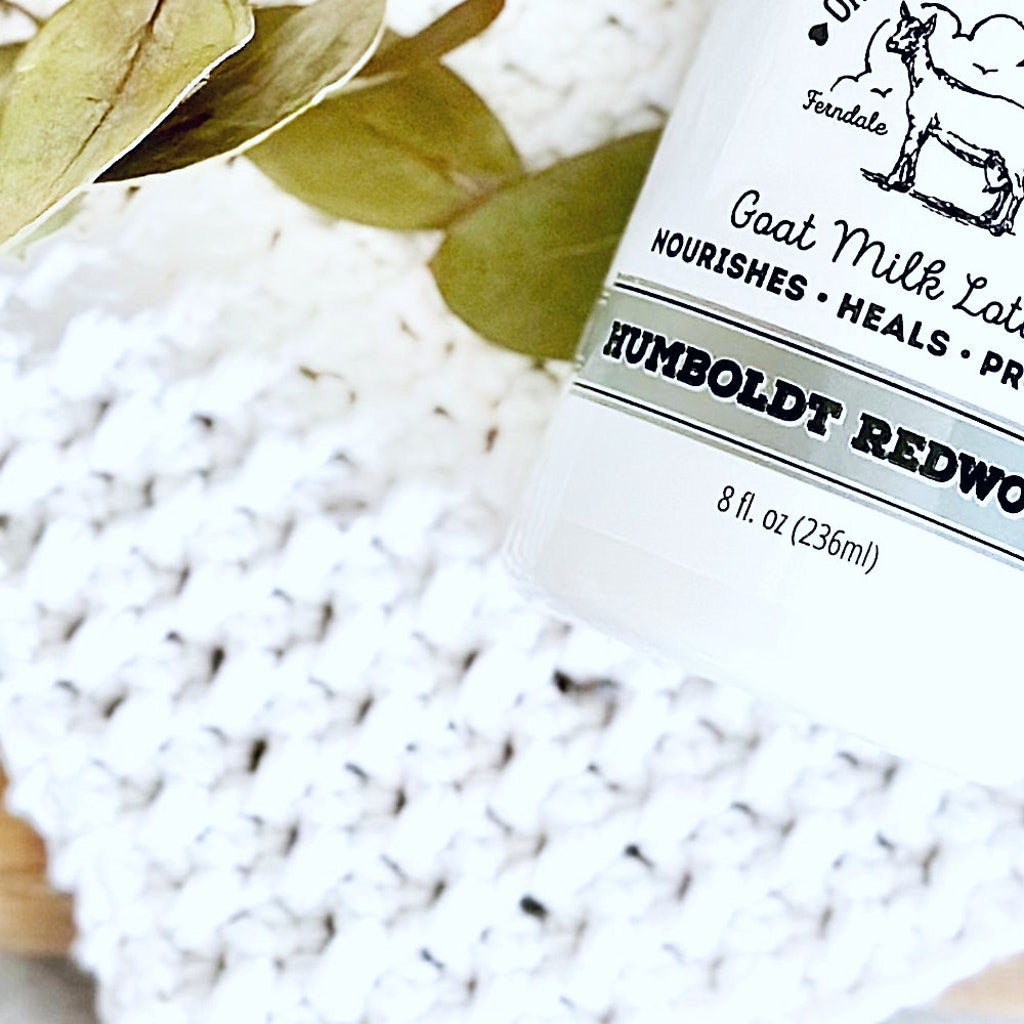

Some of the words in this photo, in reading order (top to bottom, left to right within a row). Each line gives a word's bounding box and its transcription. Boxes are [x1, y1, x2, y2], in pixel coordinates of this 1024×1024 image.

[803, 89, 888, 136] Ferndale
[650, 227, 808, 302] NOURISHES
[836, 291, 951, 357] HEALS
[731, 189, 817, 251] Goat
[832, 218, 946, 301] Milk
[602, 320, 844, 437] HUMBOLDT
[717, 485, 735, 512] 8
[735, 491, 755, 524] fl.
[762, 509, 789, 535] oz
[791, 516, 880, 575] (236ml)
